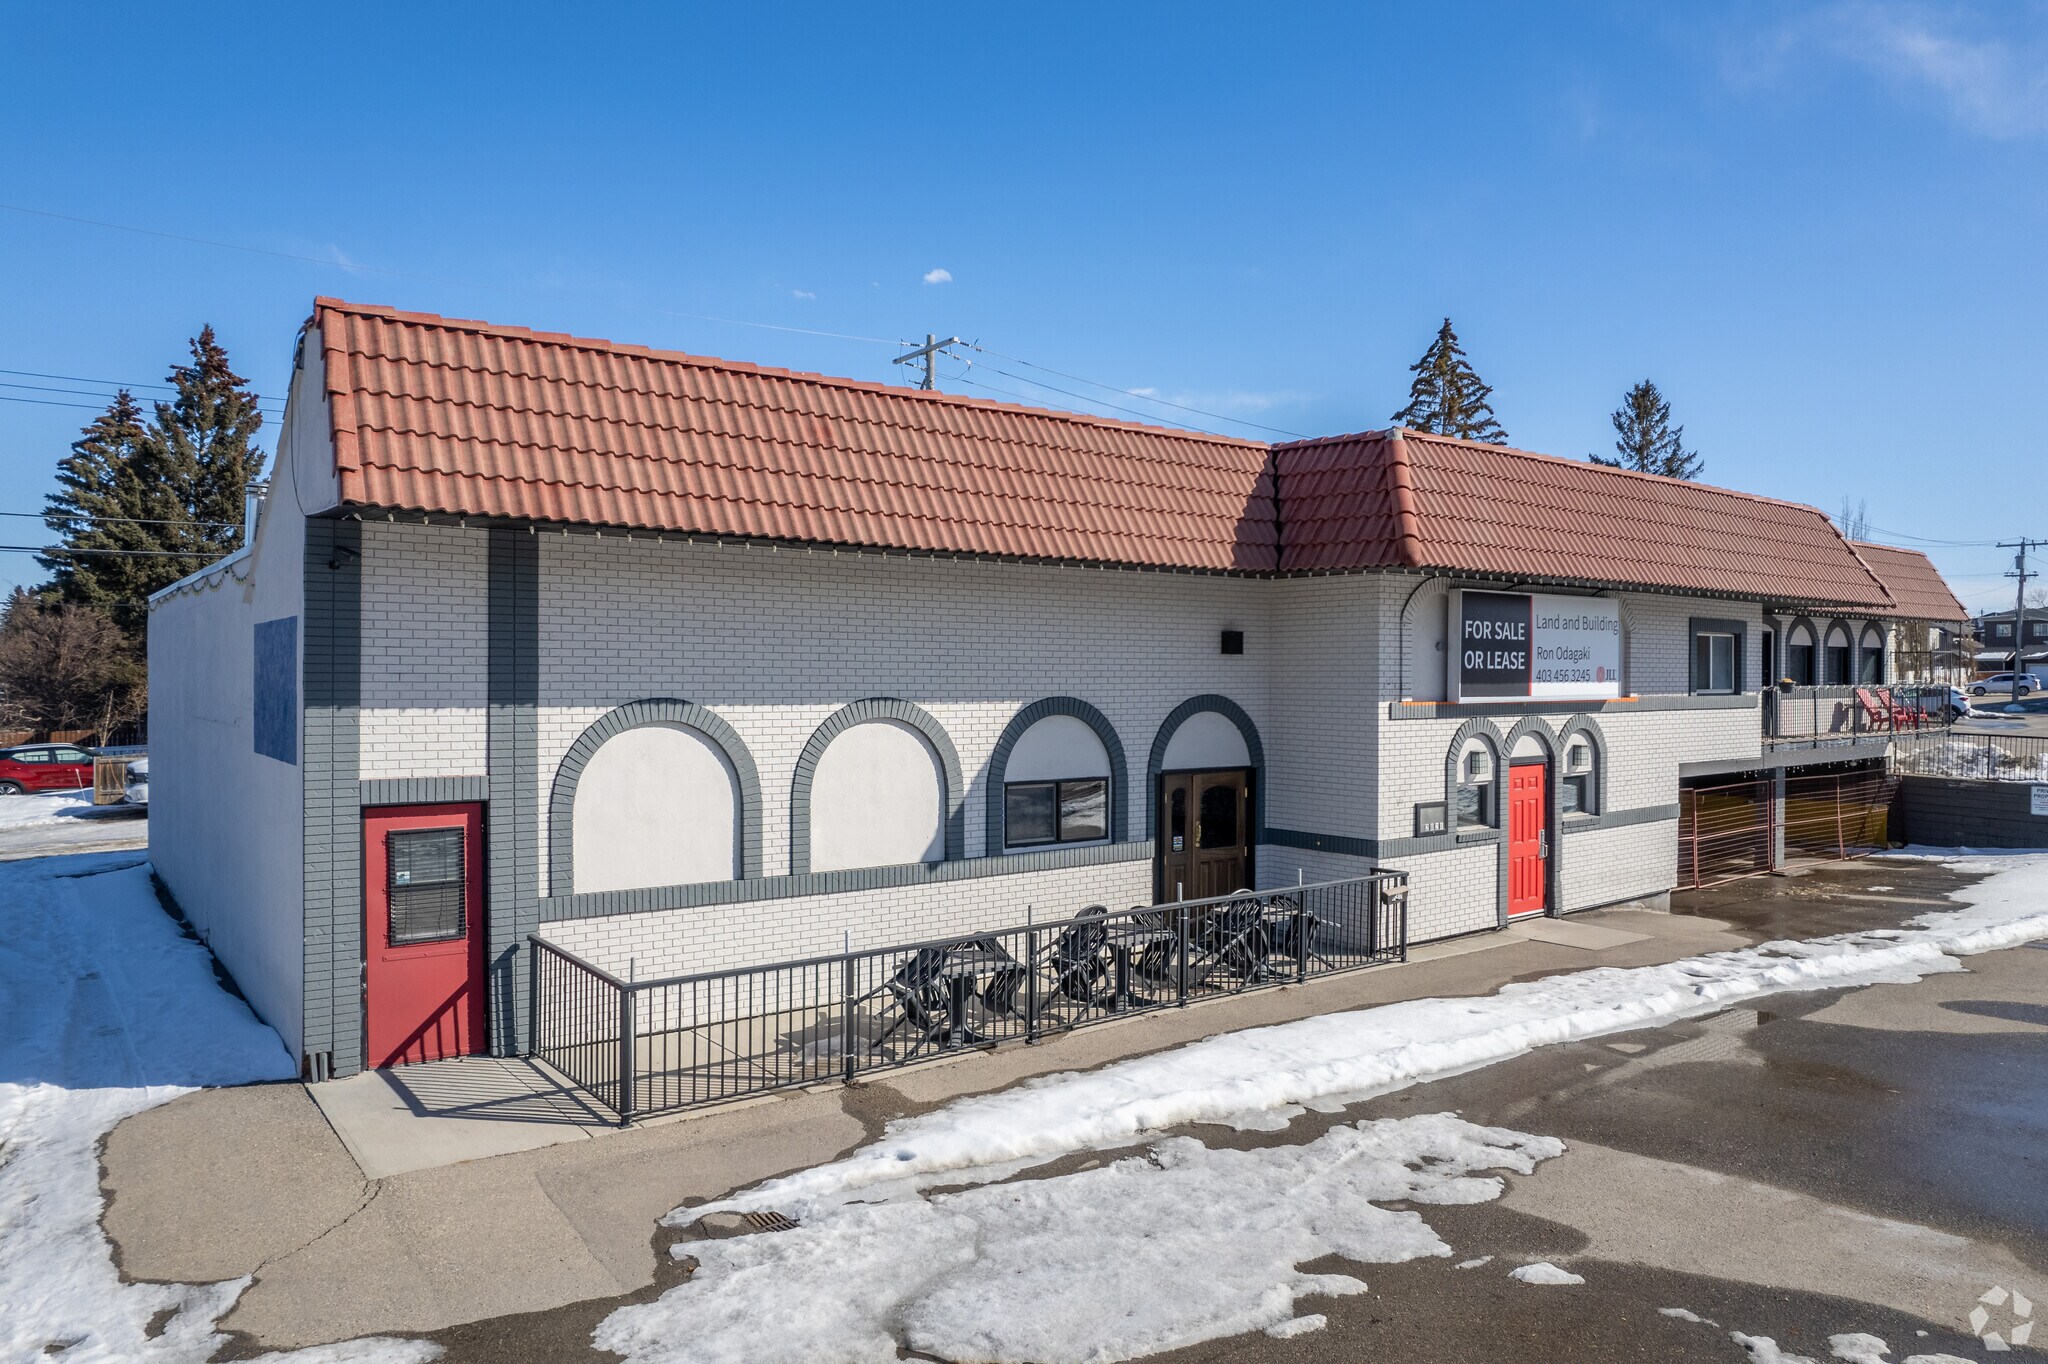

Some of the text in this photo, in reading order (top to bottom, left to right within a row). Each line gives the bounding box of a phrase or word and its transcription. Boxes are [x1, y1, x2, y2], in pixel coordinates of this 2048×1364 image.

[1465, 620, 1525, 640] FOR SALE
[1536, 614, 1618, 635] Land and Building
[1464, 650, 1526, 670] OR LEASE
[1536, 646, 1590, 664] Ron Odagaki
[1536, 669, 1552, 683] 403
[1553, 669, 1570, 683] 456
[1570, 669, 1591, 682] 3245
